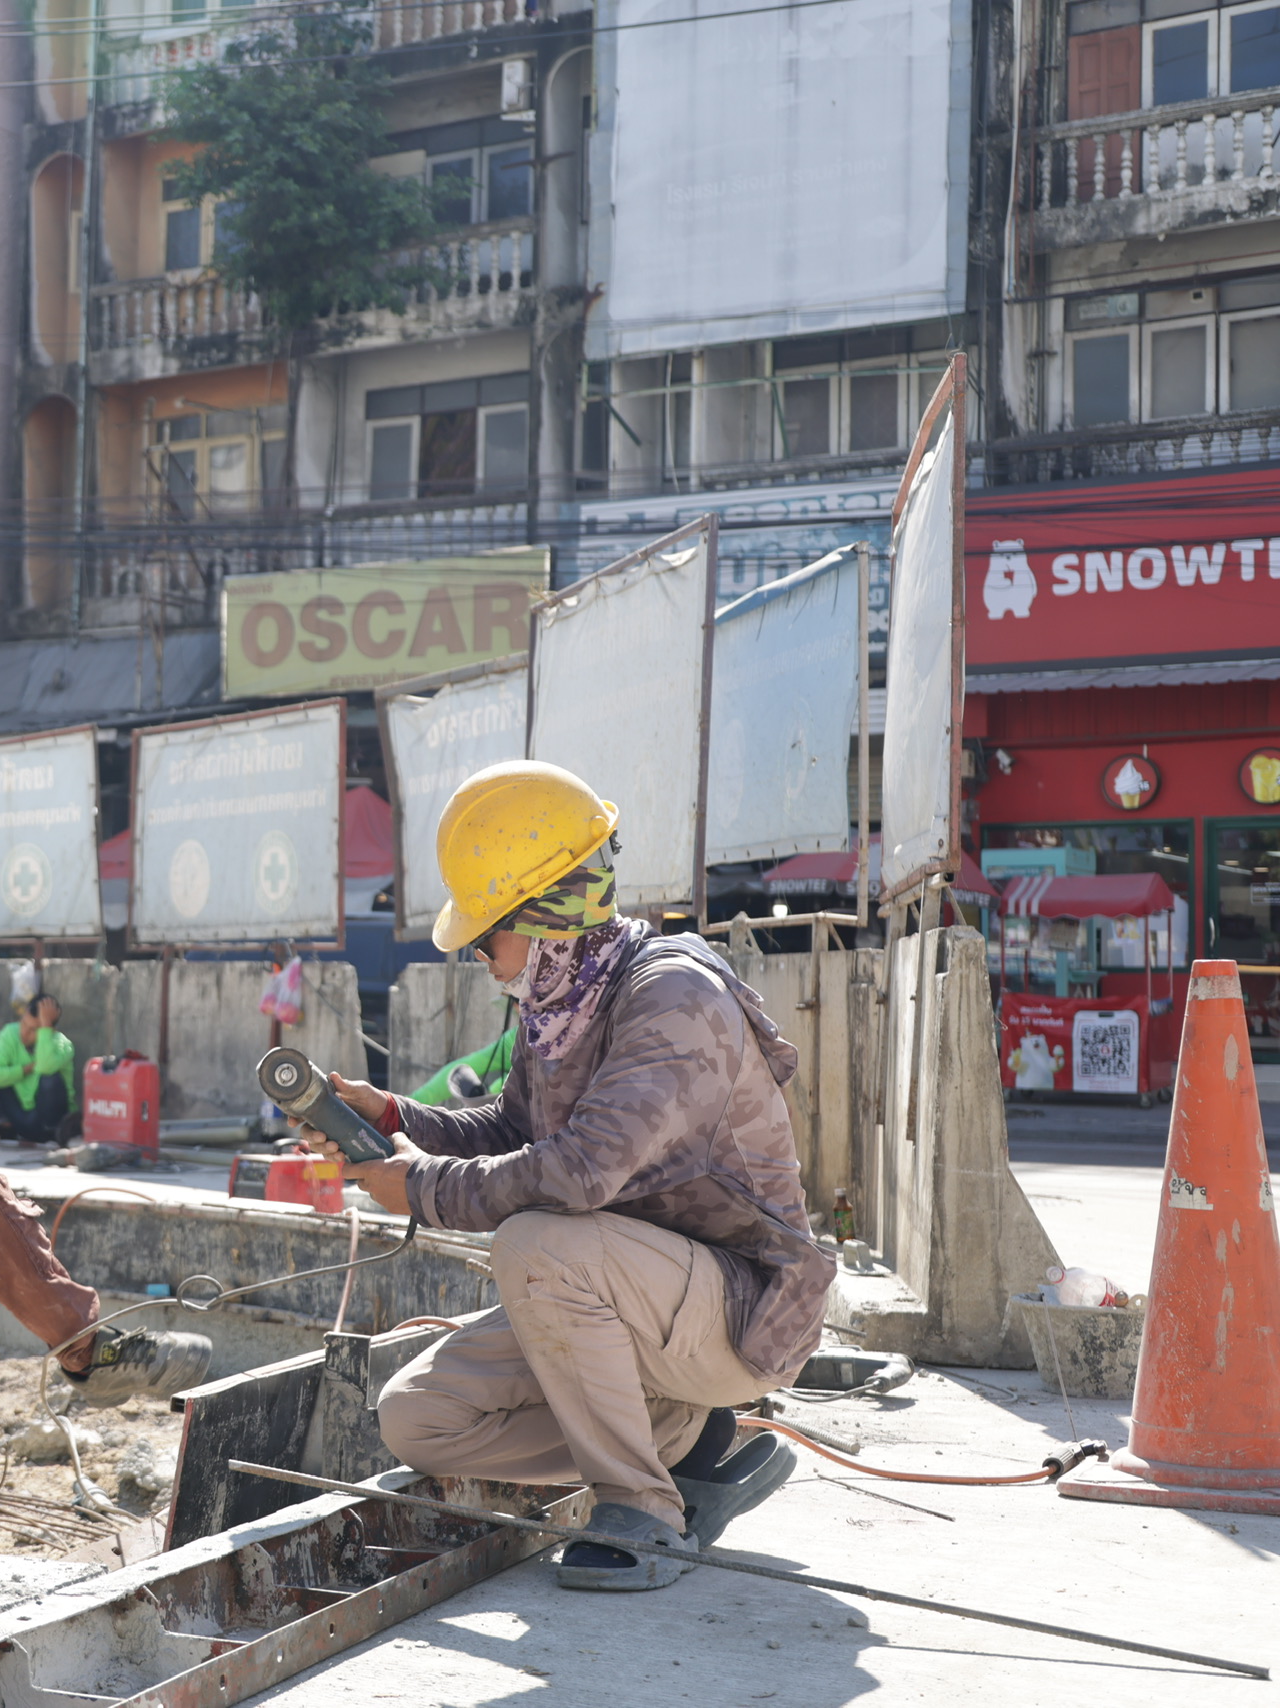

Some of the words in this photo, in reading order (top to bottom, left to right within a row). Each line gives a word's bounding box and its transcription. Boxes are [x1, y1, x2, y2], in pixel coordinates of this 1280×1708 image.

[241, 581, 532, 668] OSCAR
[770, 879, 827, 894] SNOWTEE
[88, 1099, 127, 1118] HILTI
